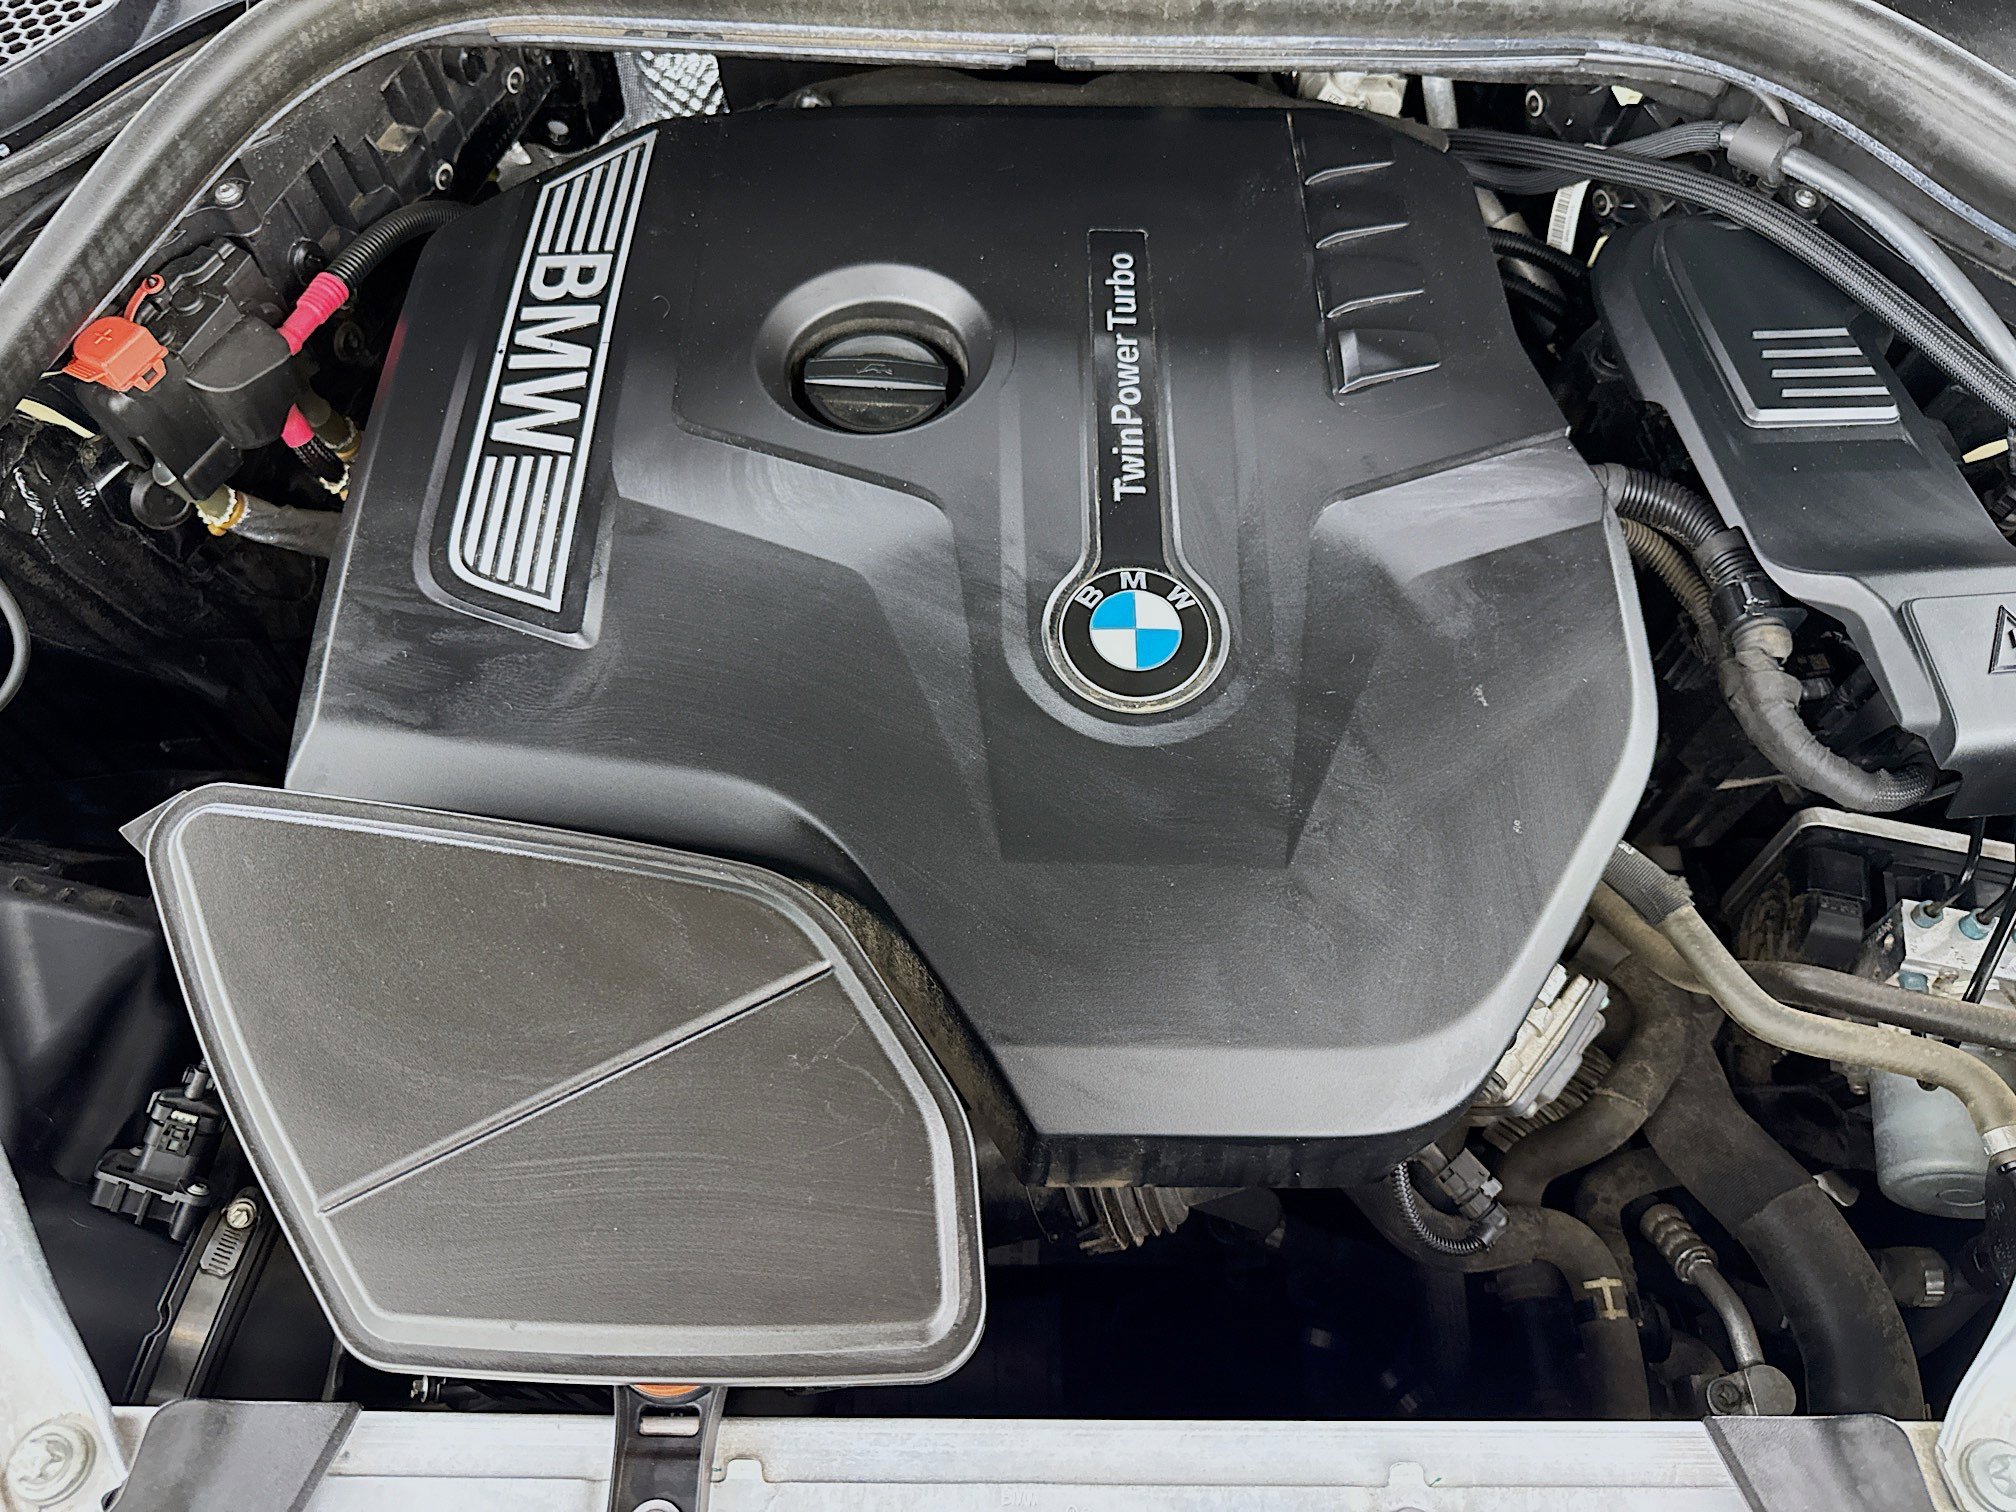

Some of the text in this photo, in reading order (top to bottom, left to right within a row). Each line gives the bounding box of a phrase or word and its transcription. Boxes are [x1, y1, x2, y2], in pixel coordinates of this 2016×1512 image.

[489, 253, 614, 455] BMW
[1104, 252, 1147, 503] TwinPower Turbo
[1074, 570, 1197, 612] BMW
